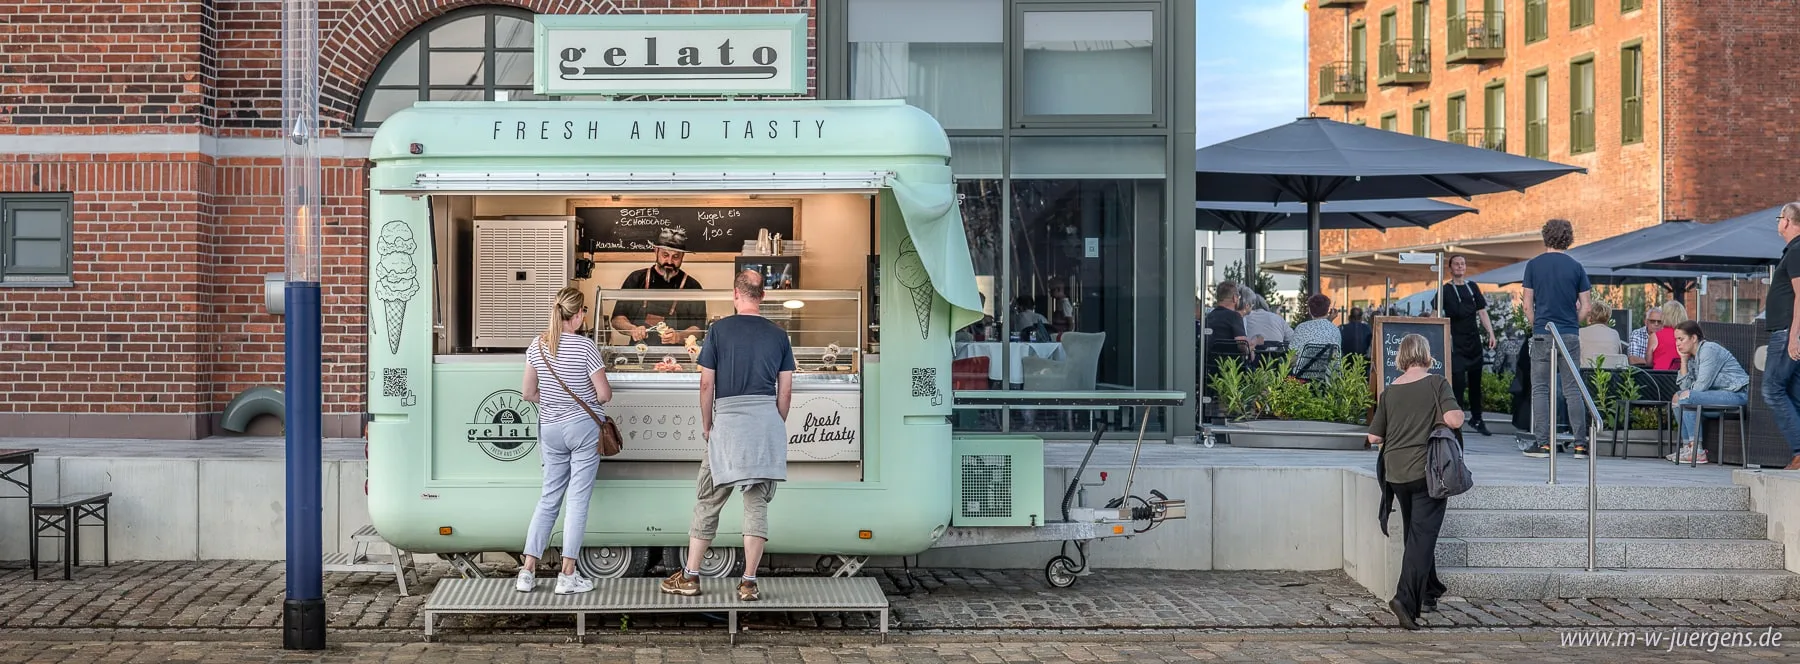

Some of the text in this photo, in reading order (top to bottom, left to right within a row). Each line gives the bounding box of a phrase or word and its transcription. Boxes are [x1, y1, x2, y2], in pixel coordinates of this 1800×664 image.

[559, 37, 778, 80] gelato
[493, 120, 825, 140] FRESH AND TASTY
[620, 217, 671, 227] SCHOKOLADE
[697, 210, 724, 226] Kugel
[484, 396, 530, 417] RIALTO
[803, 411, 840, 432] fresh
[467, 425, 533, 443] gelat
[789, 427, 855, 444] and tasty
